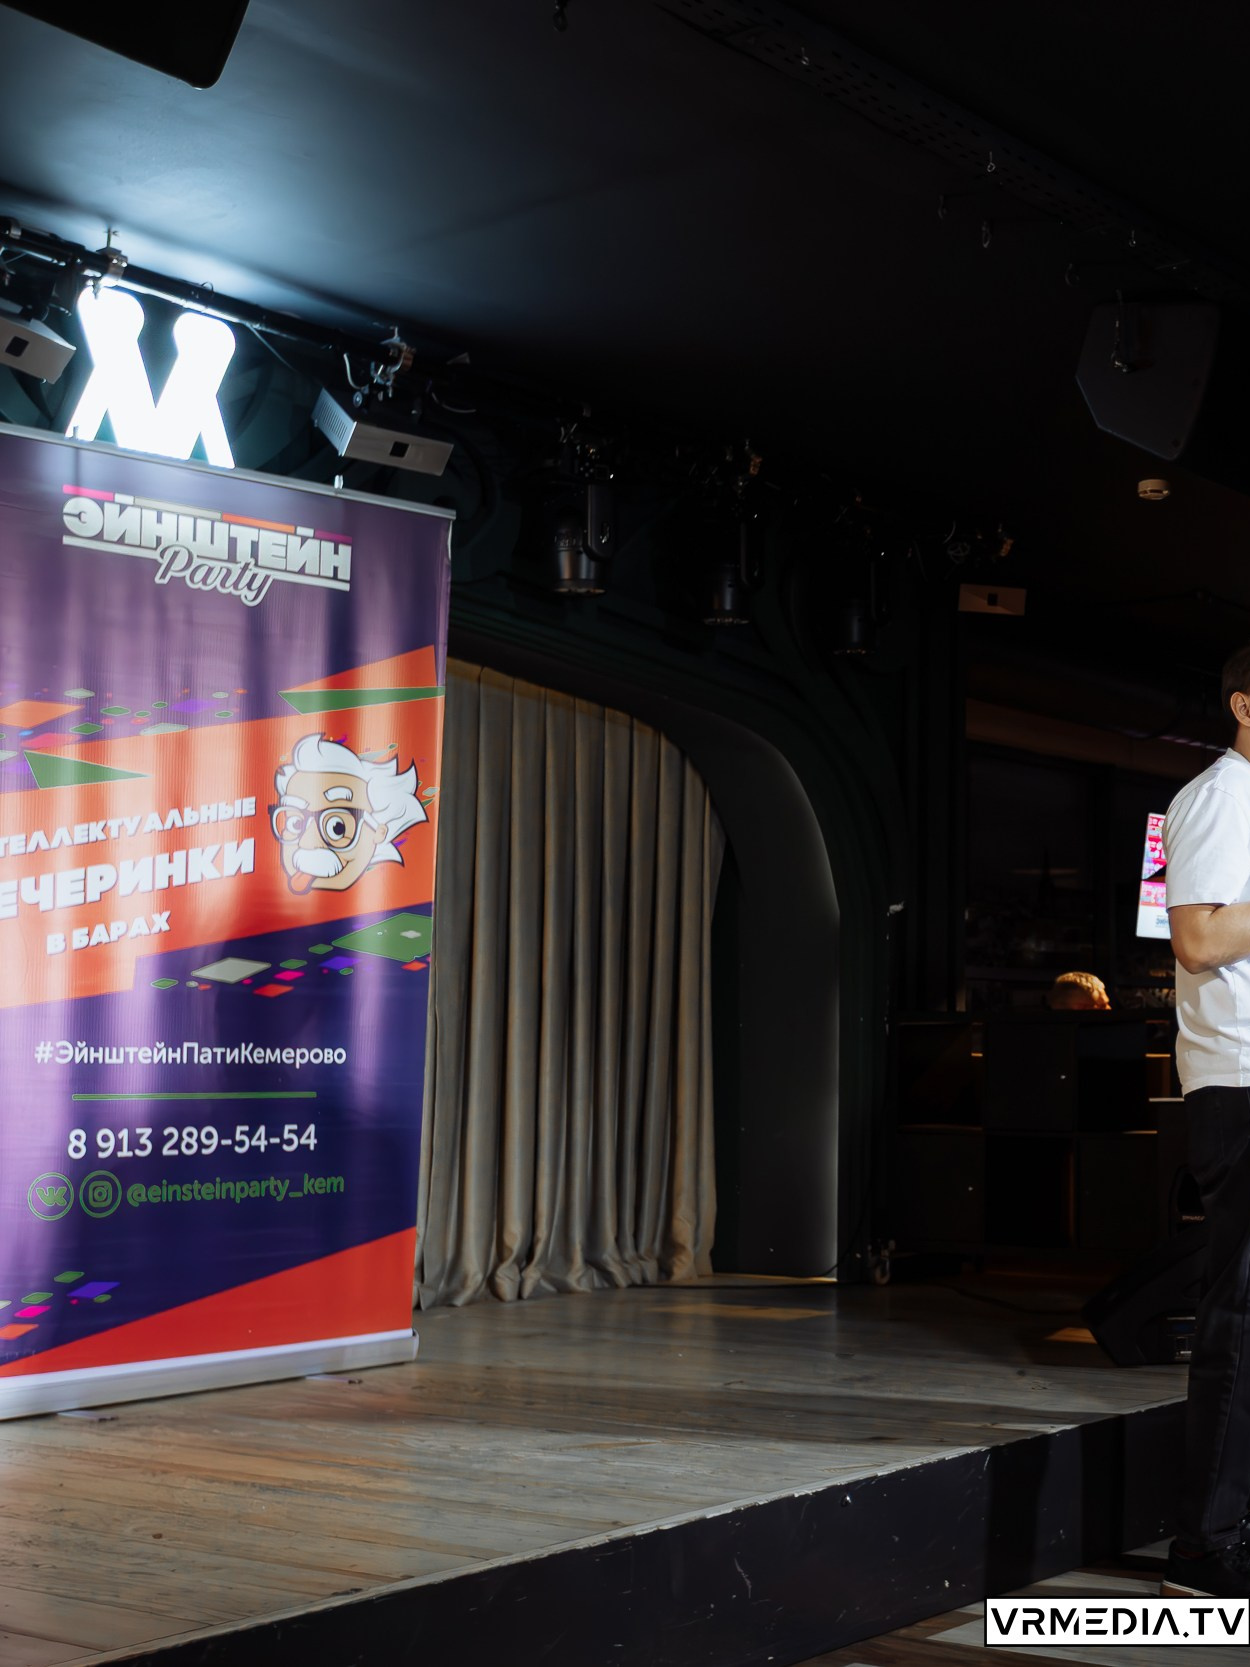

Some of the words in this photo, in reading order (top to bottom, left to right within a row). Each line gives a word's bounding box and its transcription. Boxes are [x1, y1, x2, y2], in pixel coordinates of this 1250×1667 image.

[62, 493, 352, 580] ЭЙНШТЕЙН
[155, 544, 275, 607] Party
[46, 933, 66, 955] В
[72, 911, 171, 951] БАРАХ
[34, 1041, 347, 1069] #ЭйнштейнПатиКемерово
[67, 1129, 87, 1159] 8
[97, 1128, 153, 1158] 913
[162, 1124, 318, 1156] 289-54-54
[127, 1173, 345, 1204] @einsteinparty_kem
